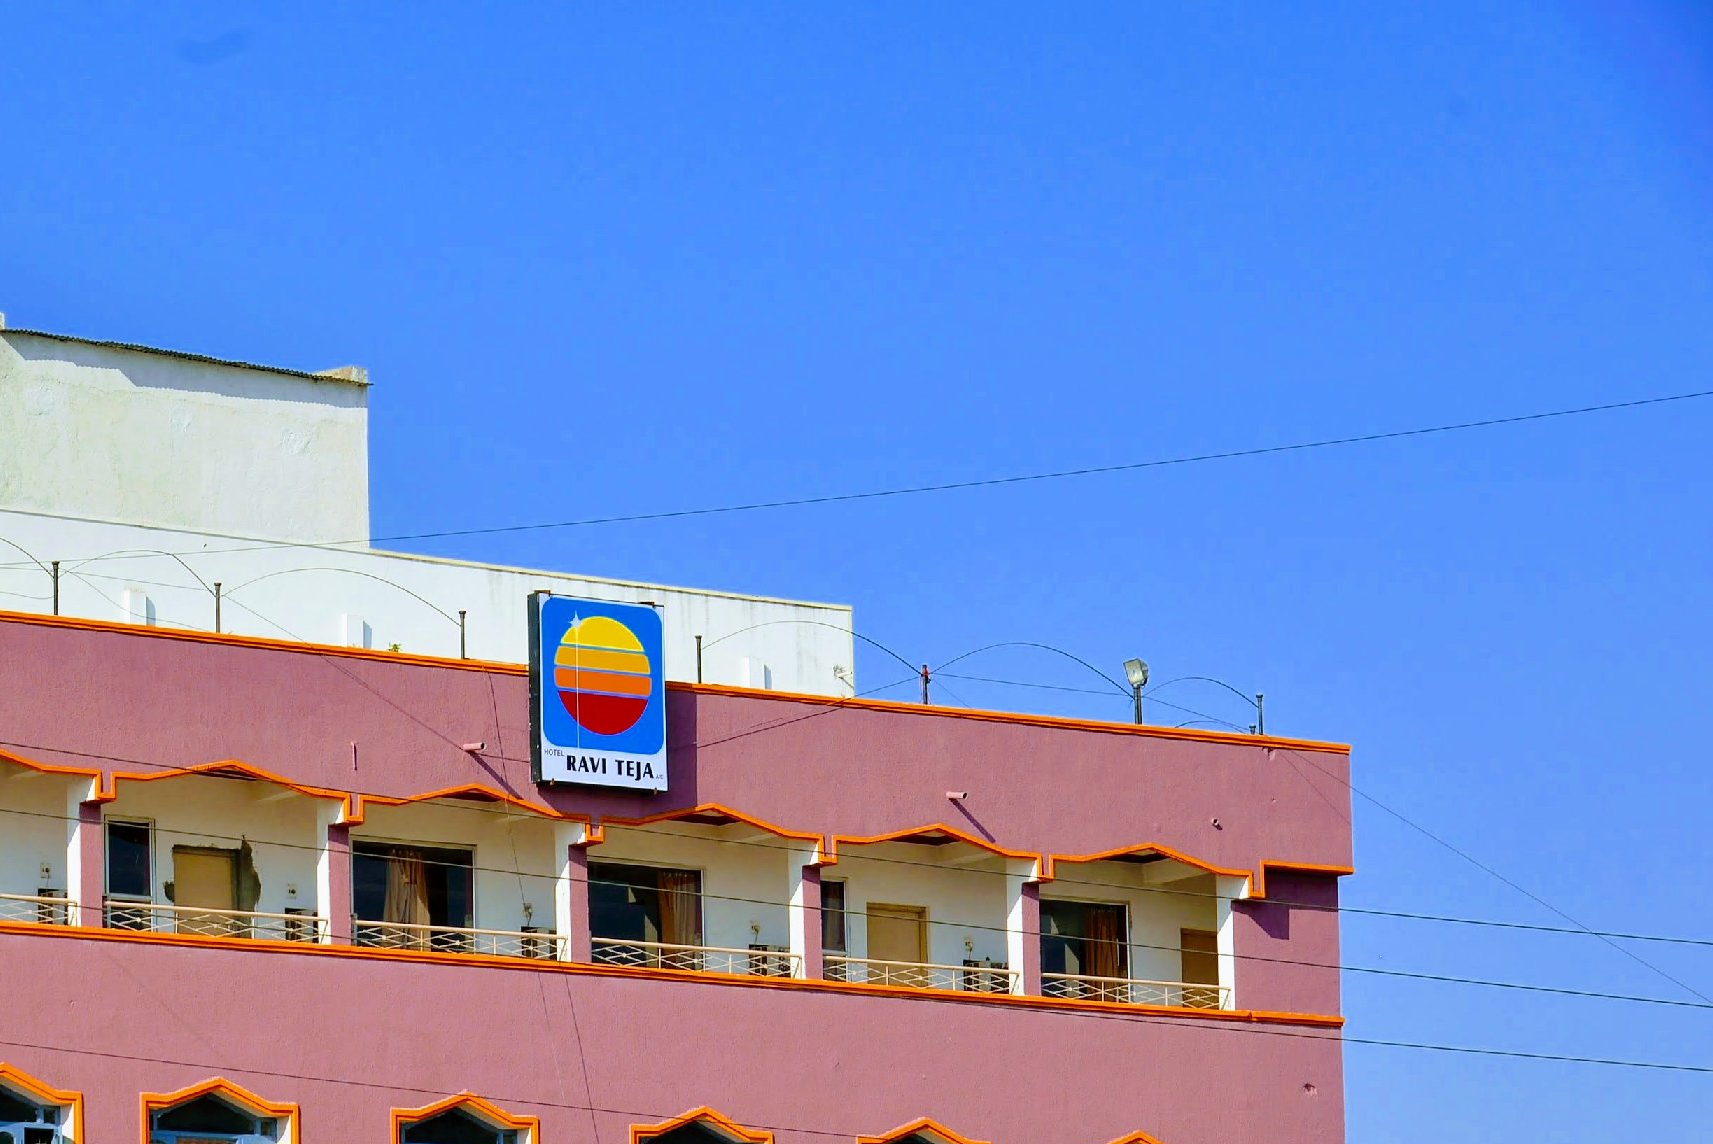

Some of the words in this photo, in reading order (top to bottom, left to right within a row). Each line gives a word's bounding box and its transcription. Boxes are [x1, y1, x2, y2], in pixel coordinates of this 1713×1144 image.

[544, 748, 565, 757] HOTEL
[566, 755, 607, 775] RAVI
[615, 759, 654, 781] TEJA
